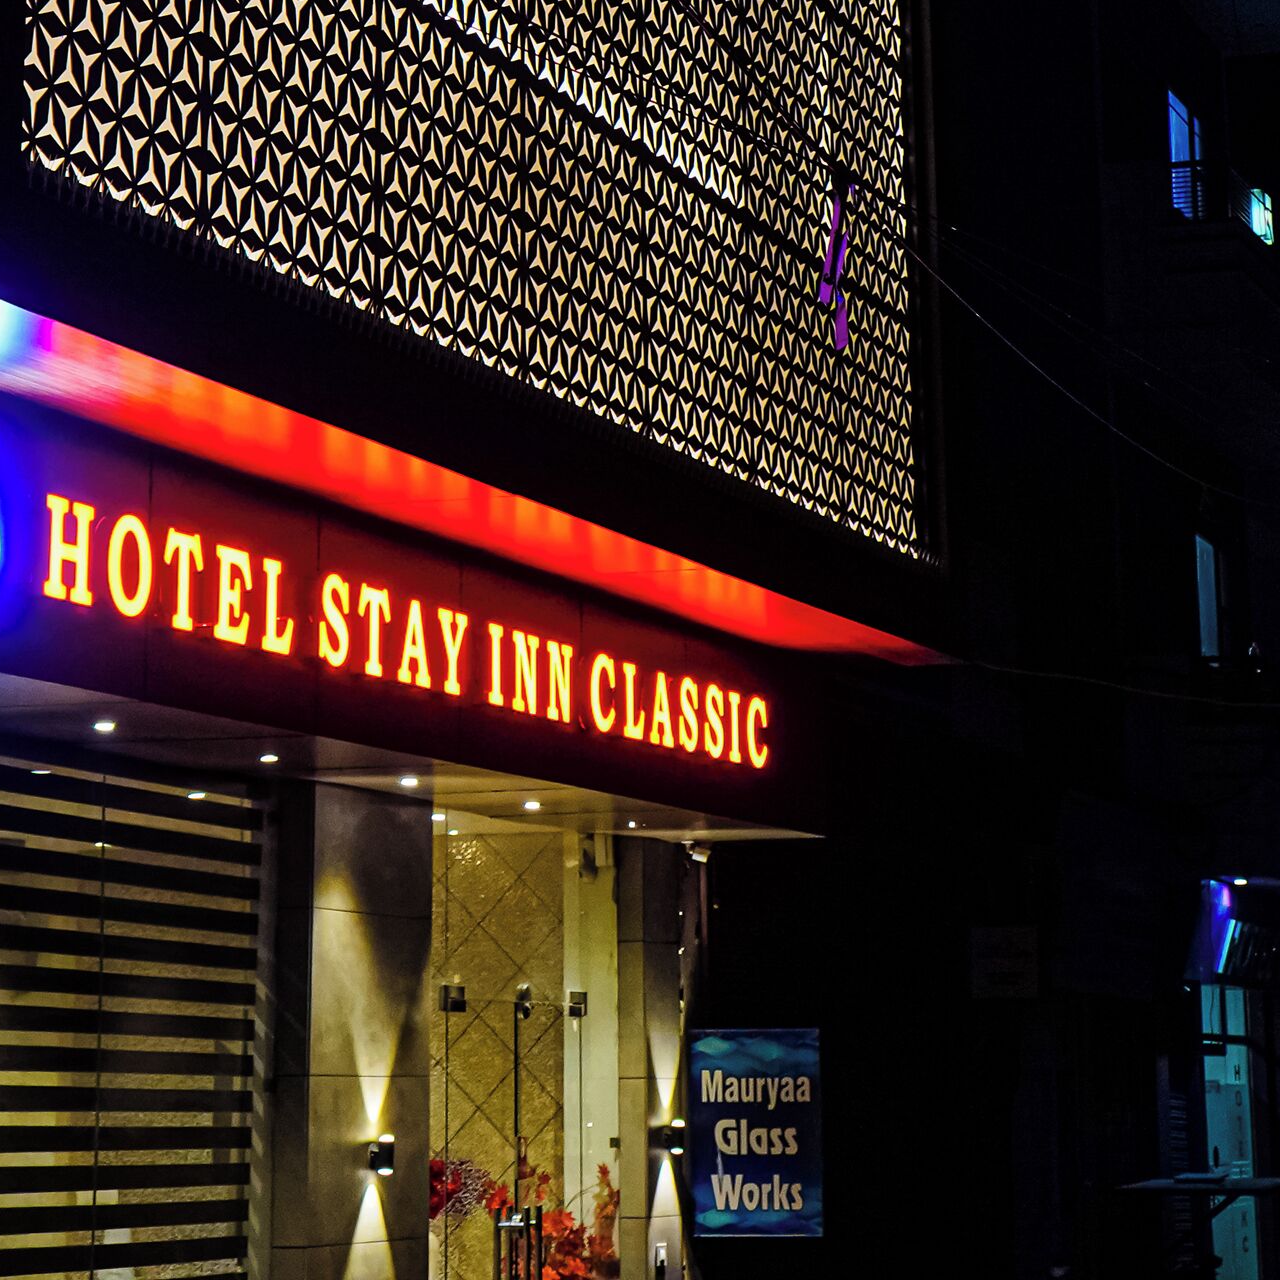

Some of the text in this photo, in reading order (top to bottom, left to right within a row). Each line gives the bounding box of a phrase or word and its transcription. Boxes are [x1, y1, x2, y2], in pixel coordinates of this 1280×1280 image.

[42, 493, 769, 770] HOTEL STAY INN CLASSIC
[700, 1069, 811, 1111] Mauryaa
[713, 1118, 799, 1156] Glass
[710, 1173, 804, 1212] Works
